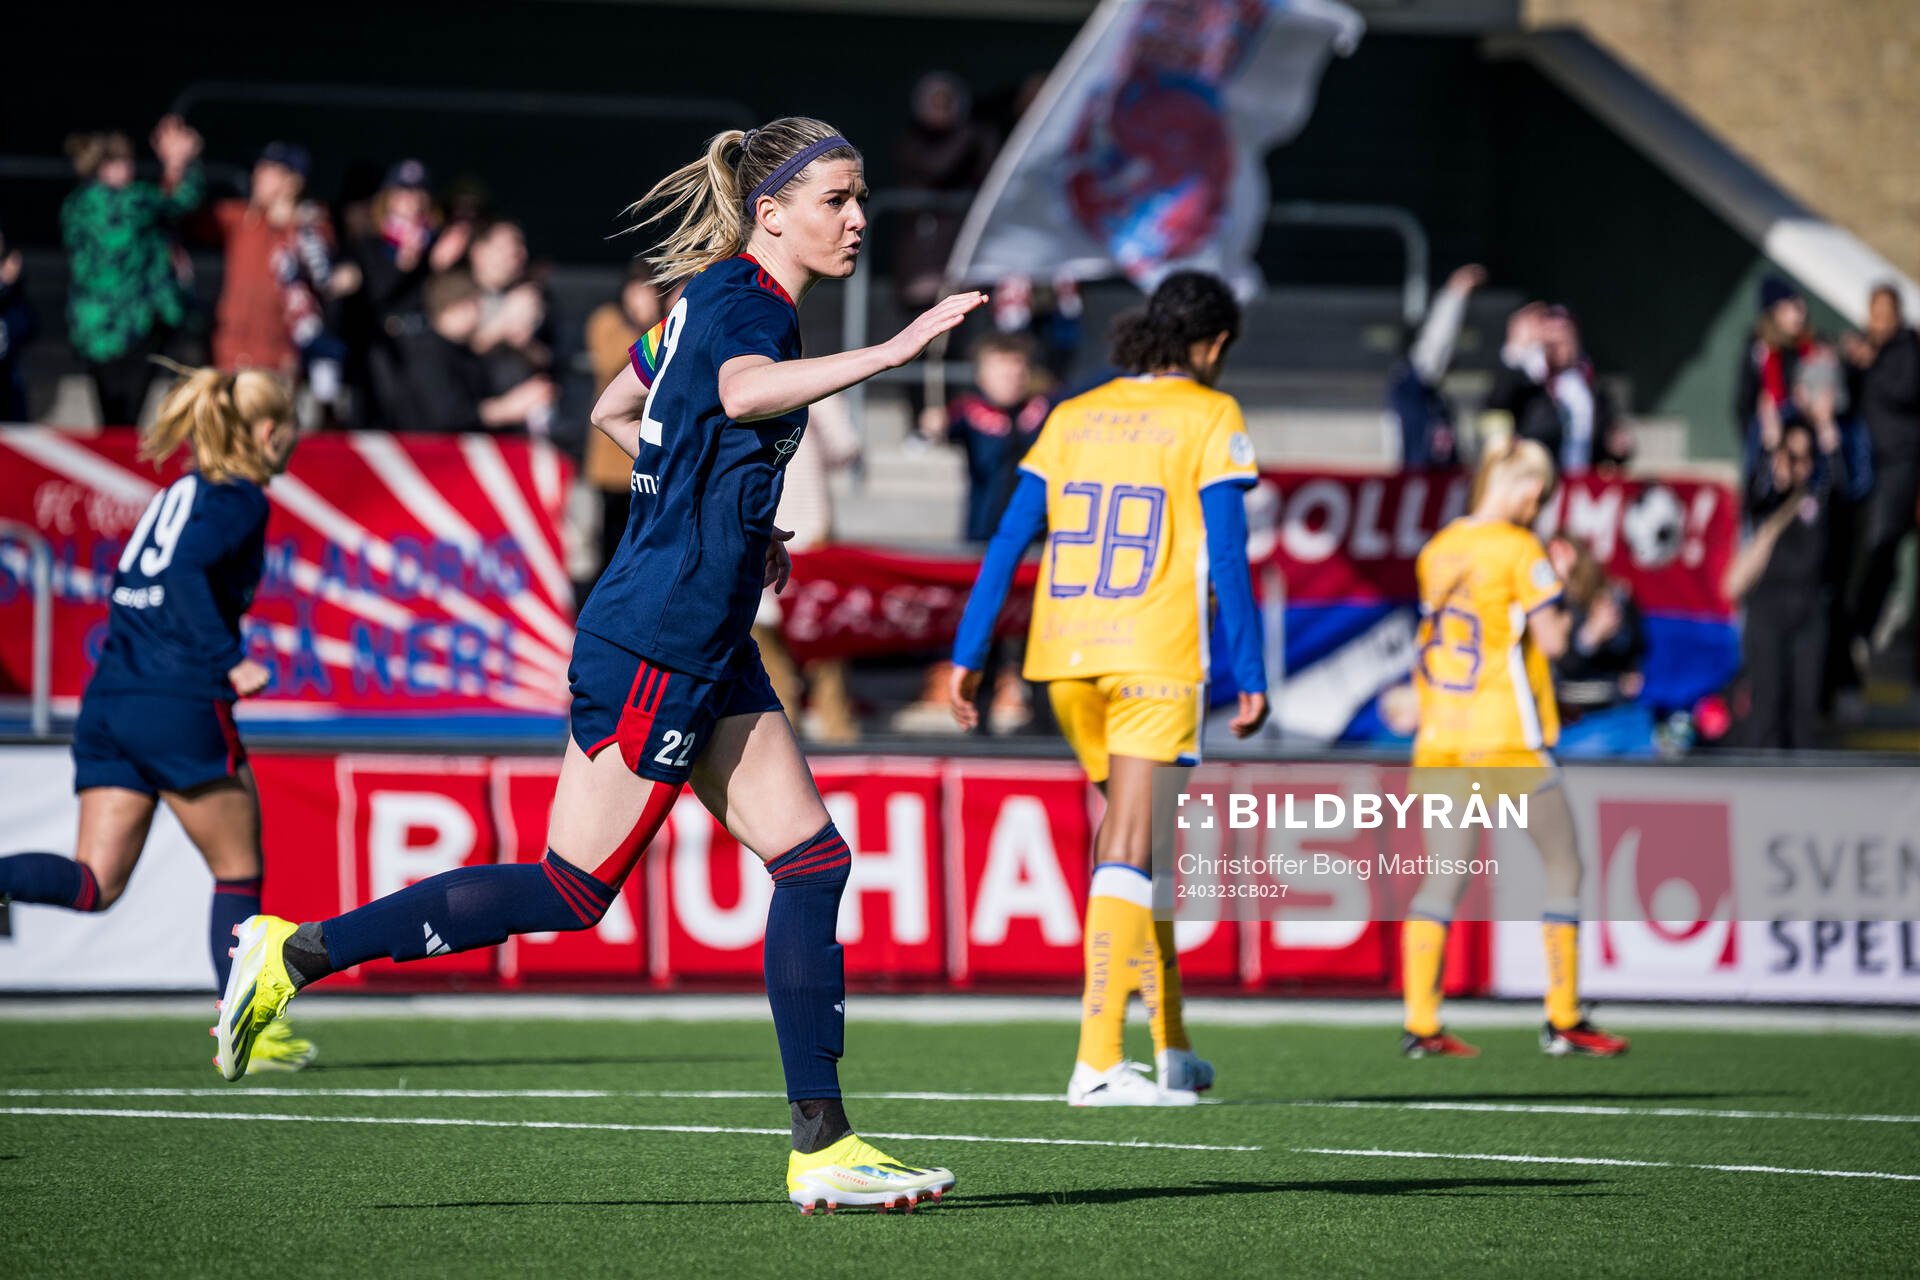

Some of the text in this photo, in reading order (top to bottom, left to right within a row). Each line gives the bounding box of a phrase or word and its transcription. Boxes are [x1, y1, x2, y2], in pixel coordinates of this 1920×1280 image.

[118, 474, 197, 577] 19
[1050, 482, 1166, 598] 28
[653, 729, 697, 768] 22
